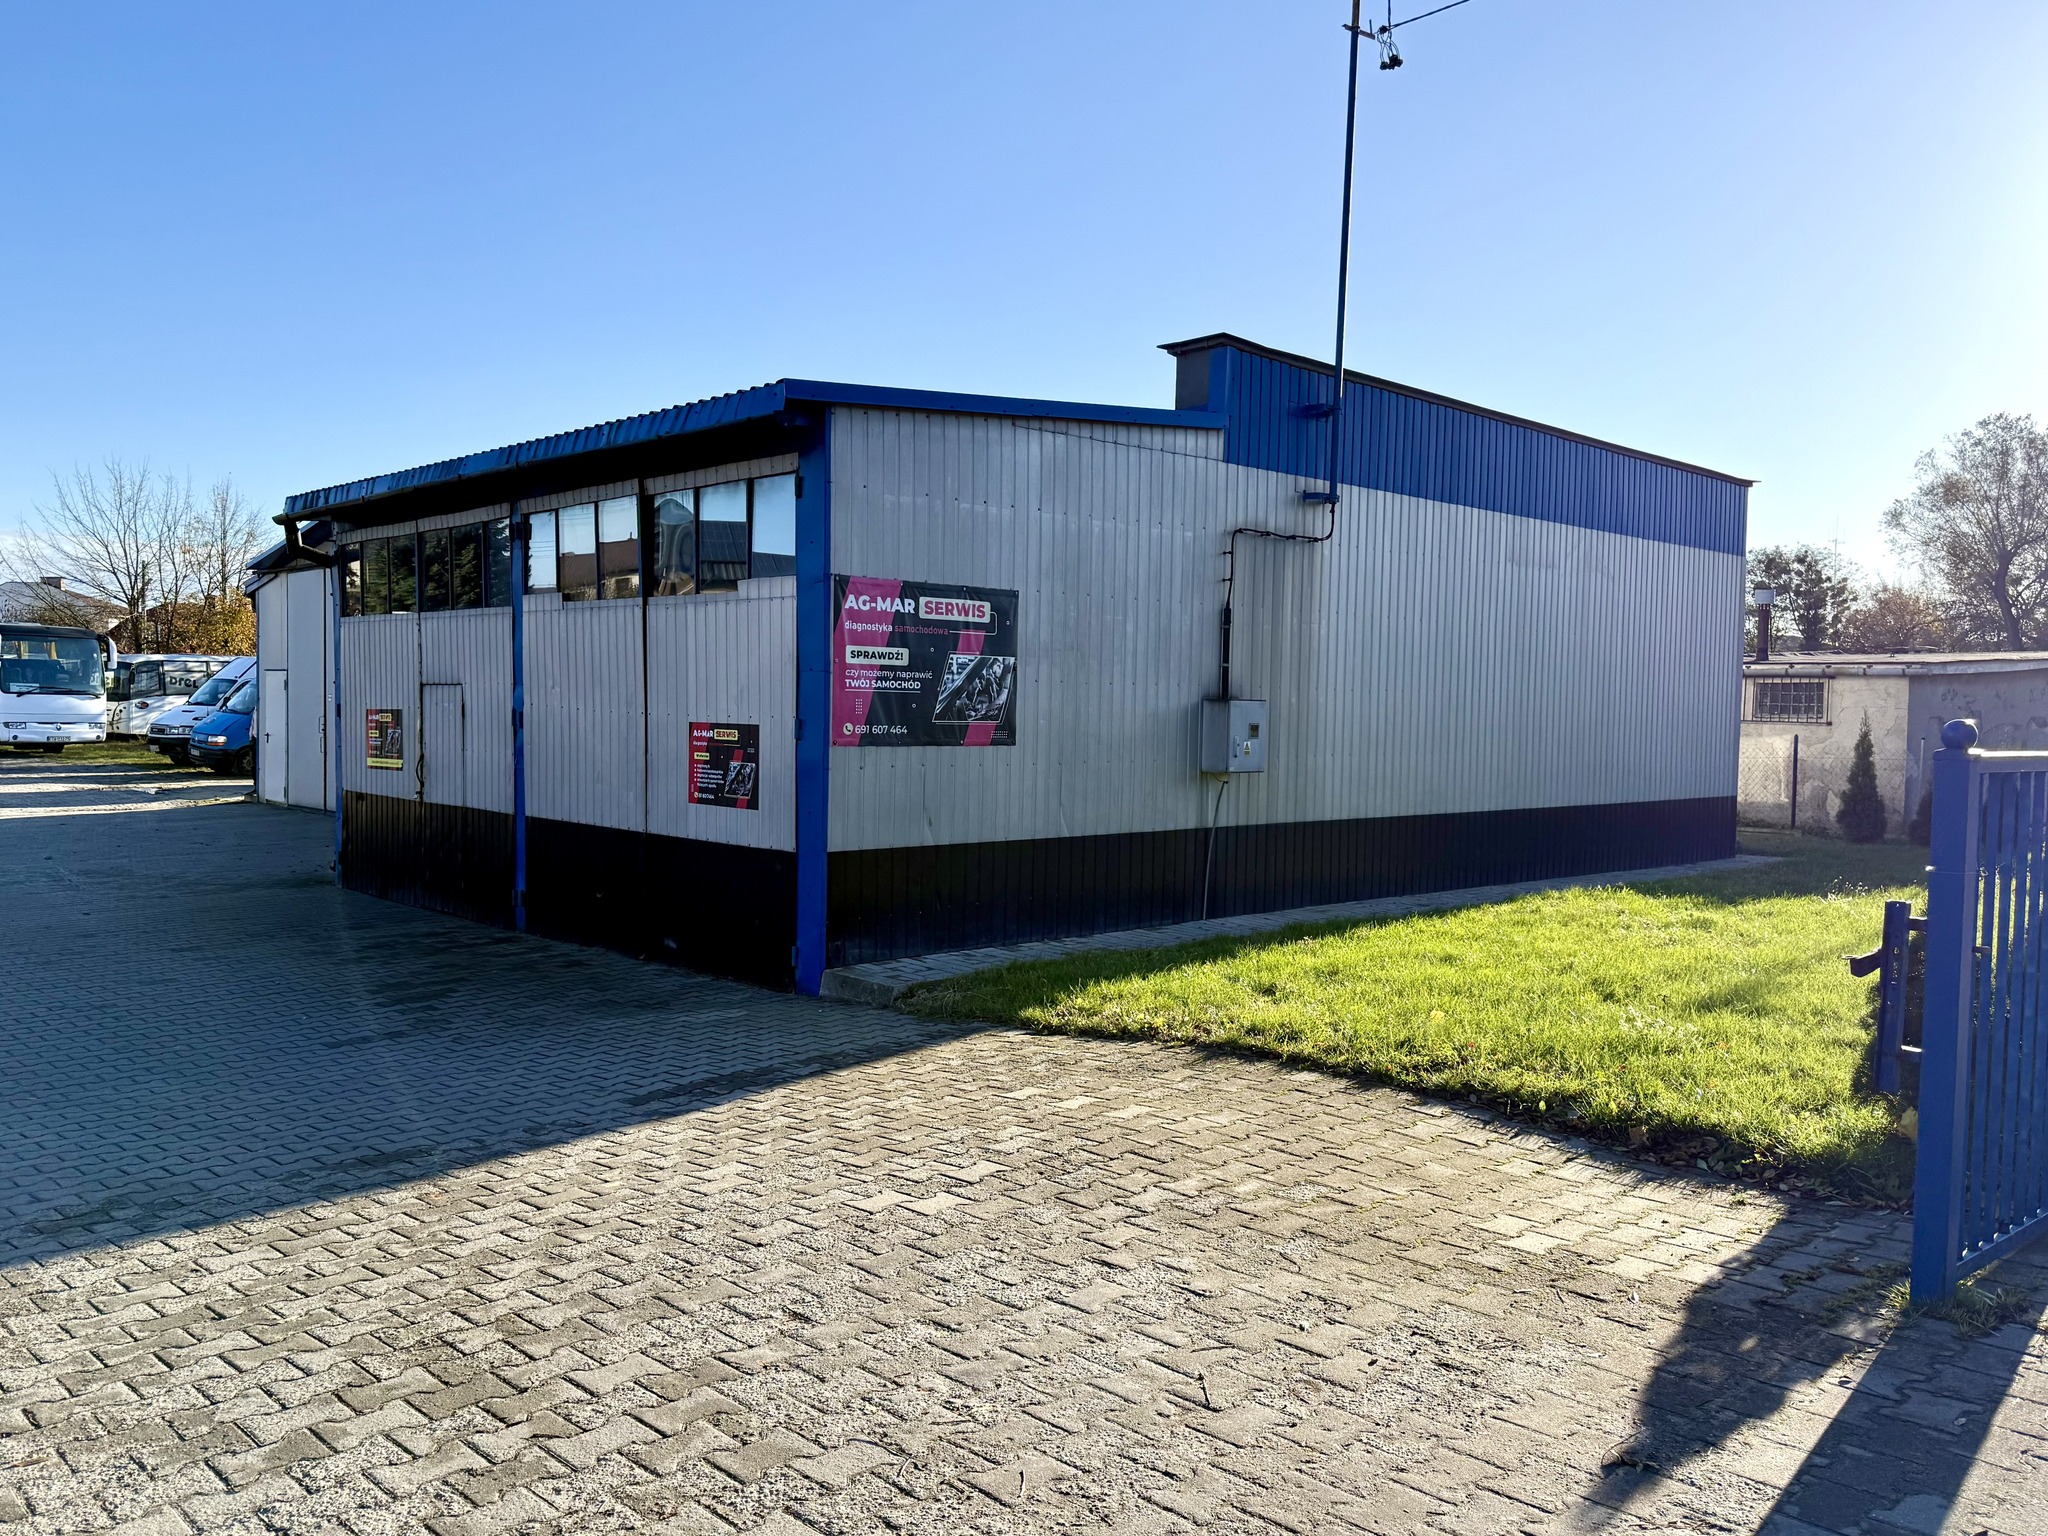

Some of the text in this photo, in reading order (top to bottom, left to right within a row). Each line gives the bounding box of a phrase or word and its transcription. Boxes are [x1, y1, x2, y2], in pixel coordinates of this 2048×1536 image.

[845, 594, 986, 618] AG-MAR SERWIS
[845, 620, 949, 635] diagnostyka samochodowa
[850, 650, 904, 661] SPRAWDŹ!
[845, 669, 933, 679] czy możemy naprawić
[845, 678, 921, 689] TWÓJ SAMOCHÓD
[715, 731, 737, 739] SERWIS
[855, 725, 908, 734] 691 607 464
